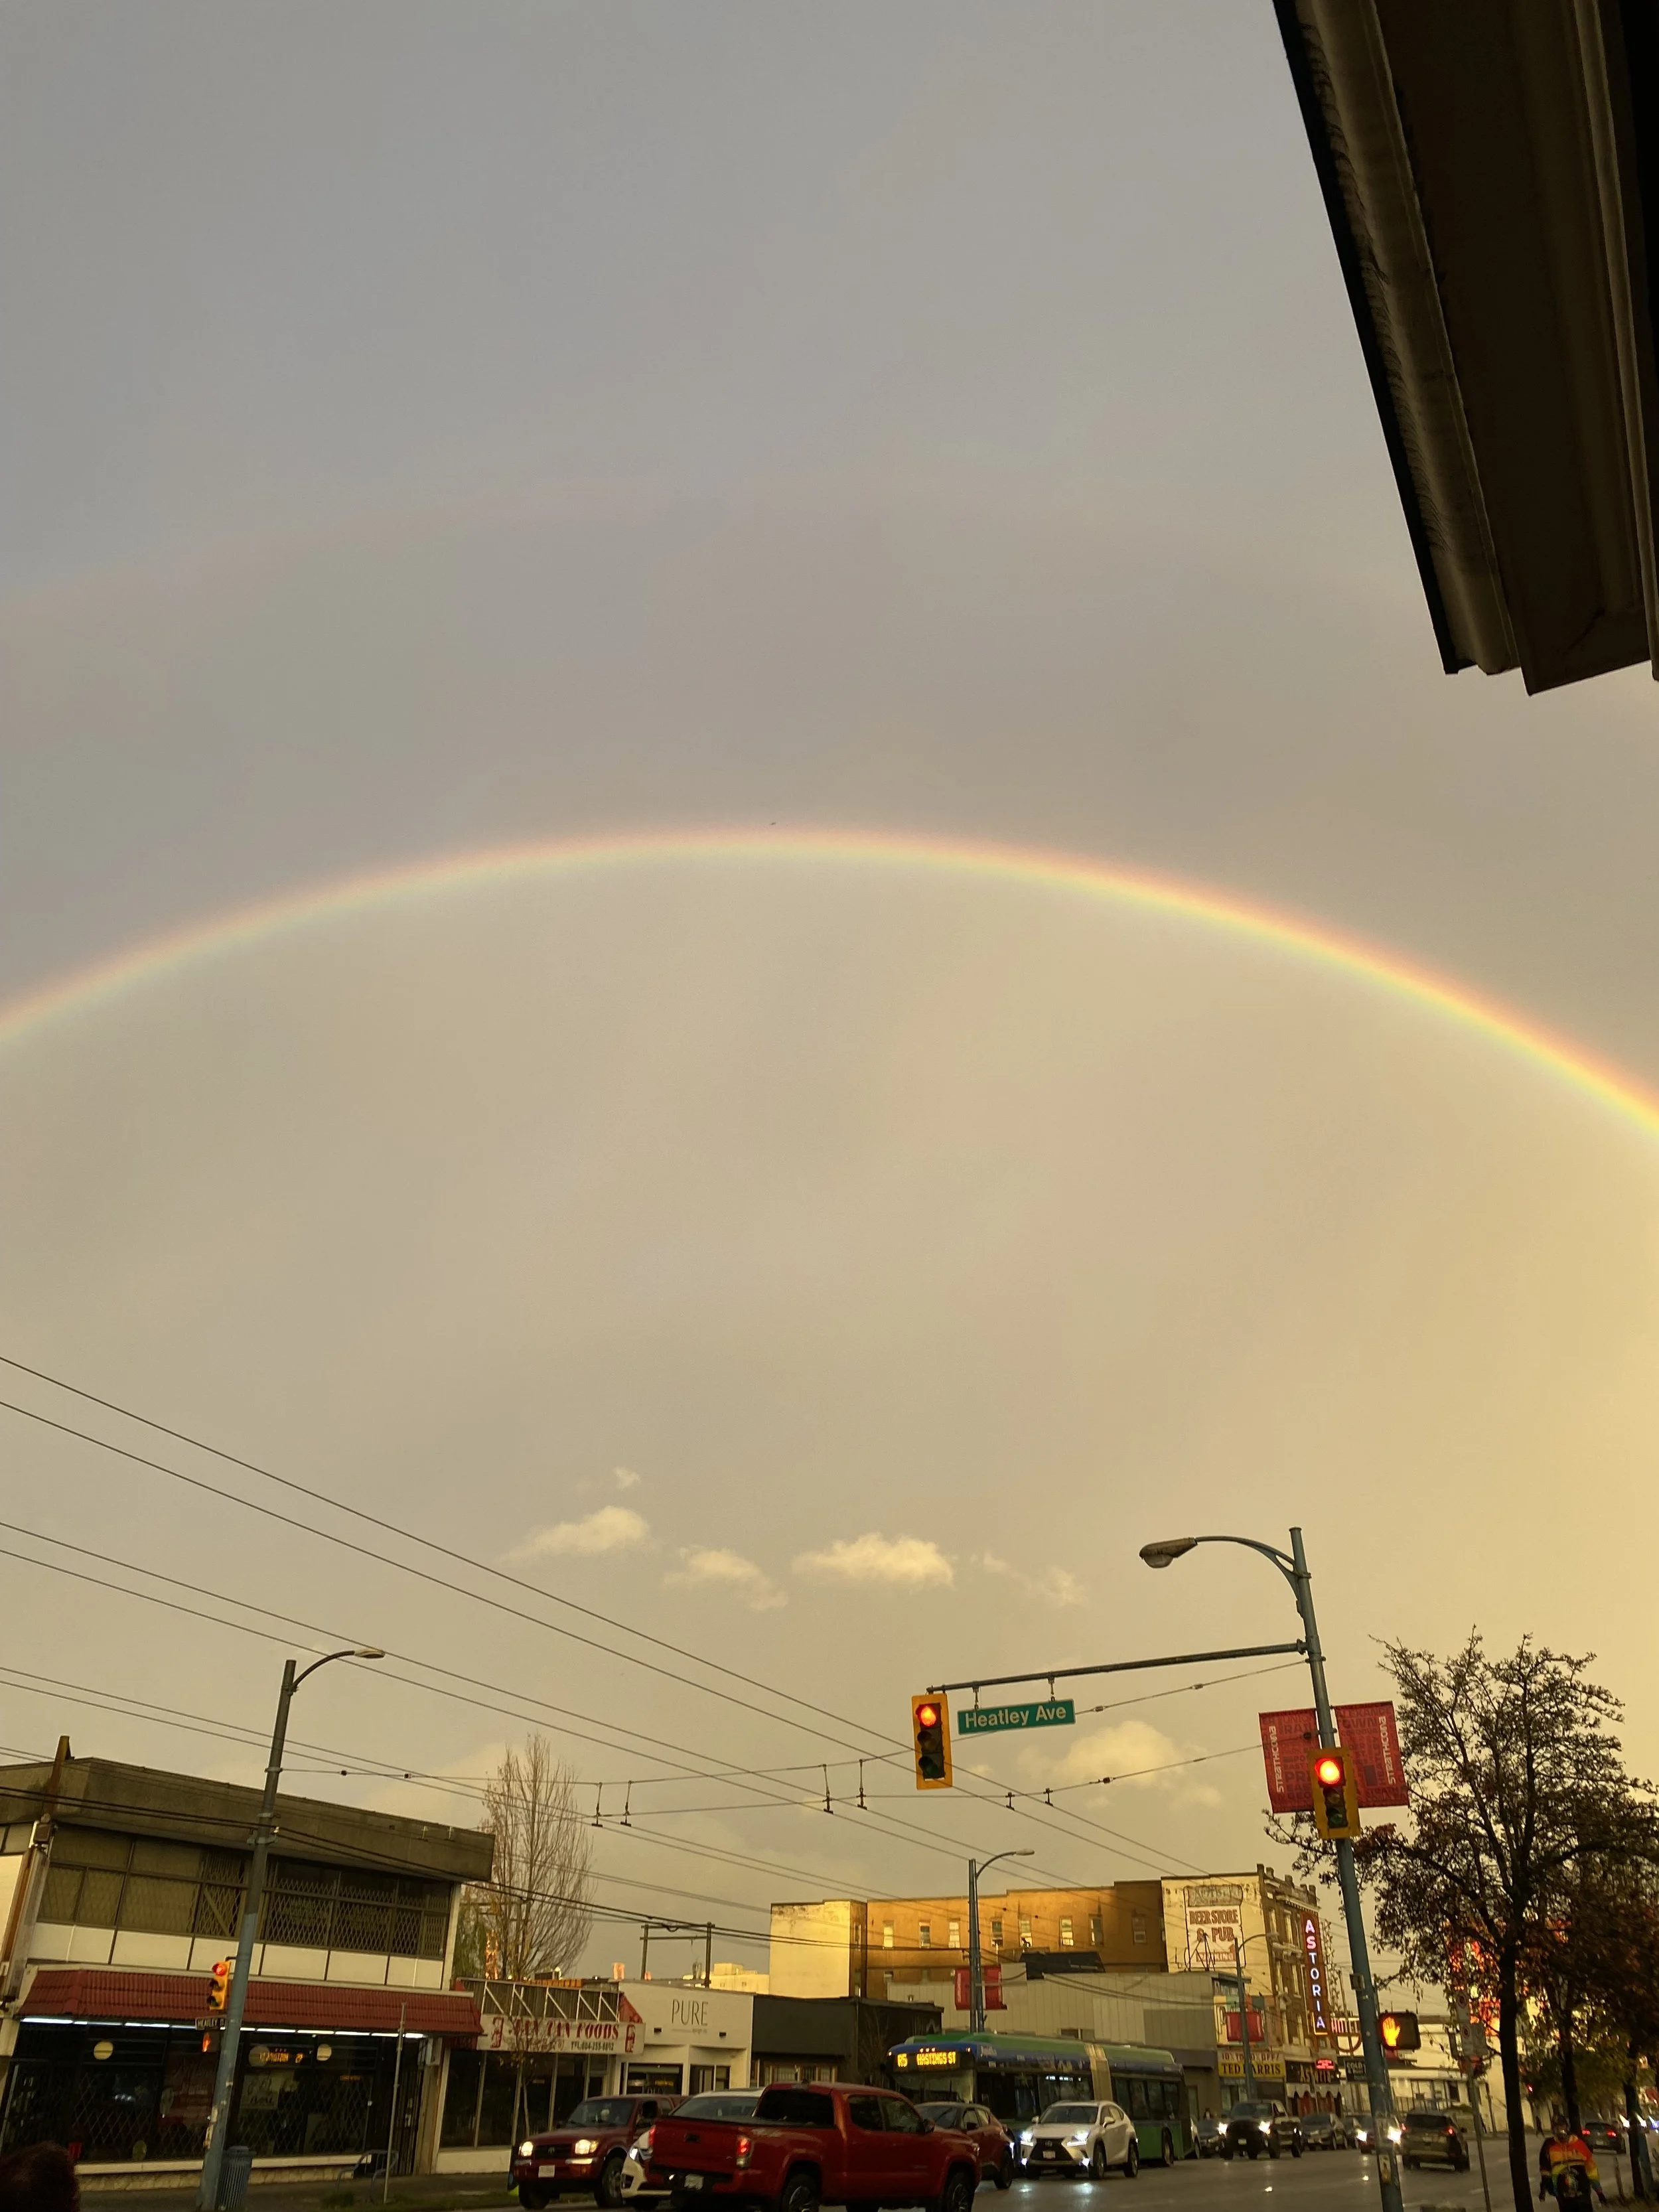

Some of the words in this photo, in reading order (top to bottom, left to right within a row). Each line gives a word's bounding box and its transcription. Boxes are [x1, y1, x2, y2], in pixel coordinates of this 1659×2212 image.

[966, 1709, 1029, 1728] Heatley
[1036, 1705, 1066, 1722] Ave
[1189, 1911, 1212, 1925] BEER
[1211, 1909, 1239, 1924] STORE
[1212, 1927, 1234, 1943] PUB
[1305, 1919, 1326, 2029] ASTORIA
[672, 1998, 708, 2026] PURE
[576, 2023, 619, 2039] FOODS
[1331, 2018, 1358, 2033] HOTEL
[897, 2053, 908, 2067] R5
[916, 2052, 947, 2065] HASTINGS
[948, 2051, 956, 2064] ST
[1222, 2063, 1241, 2074] TED
